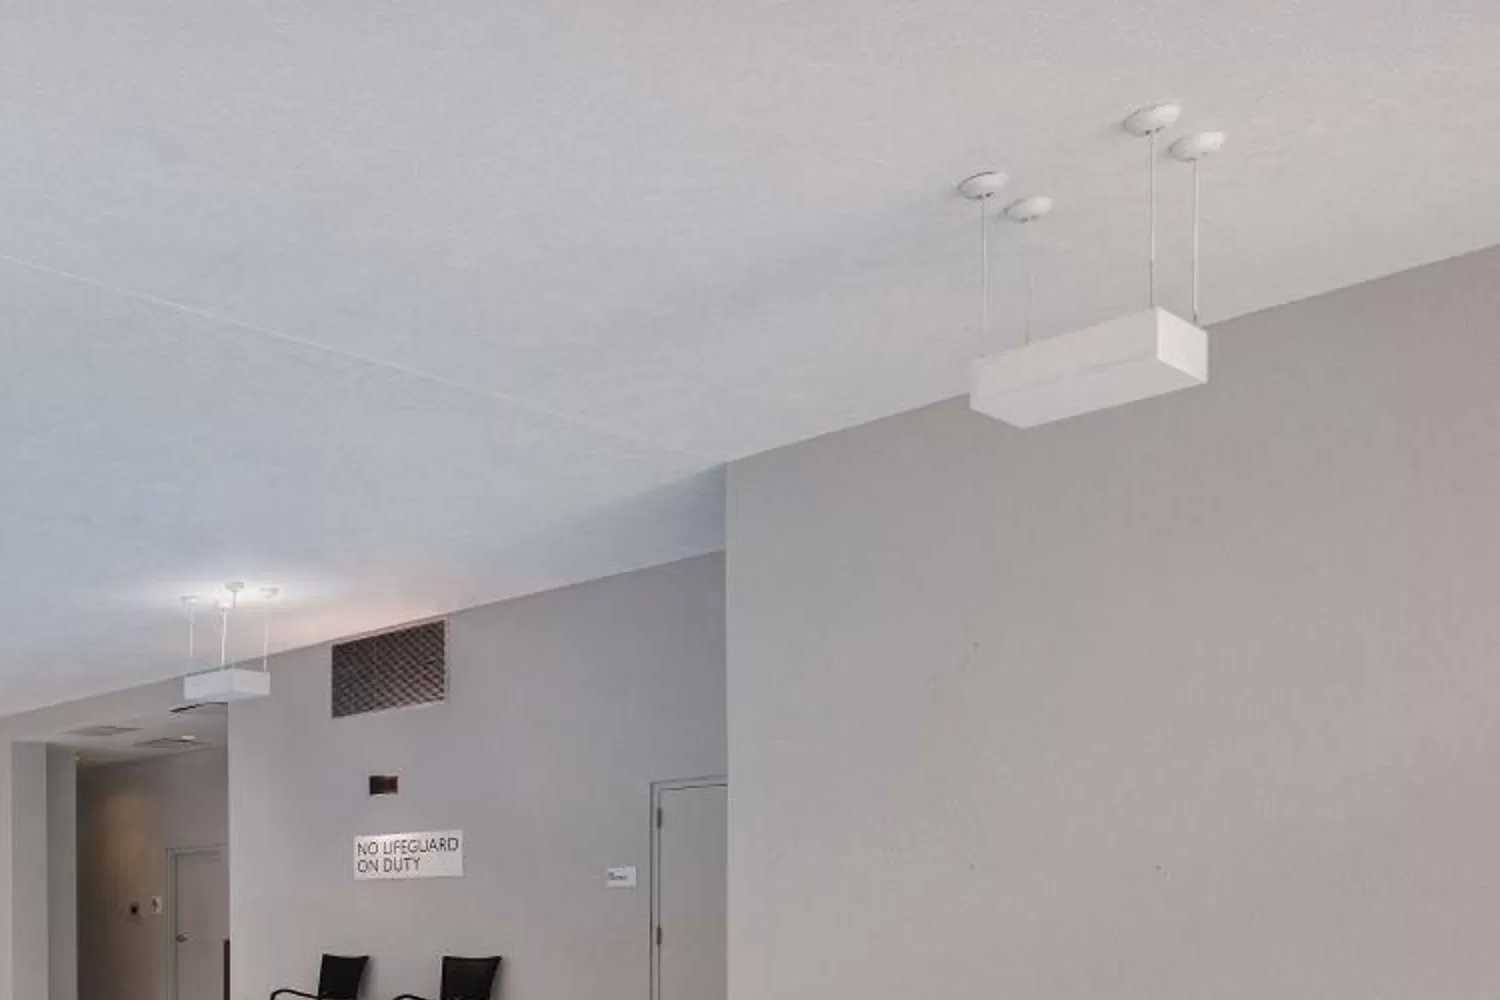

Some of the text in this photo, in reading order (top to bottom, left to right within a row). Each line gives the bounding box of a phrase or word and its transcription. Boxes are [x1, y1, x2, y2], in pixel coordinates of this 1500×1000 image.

[357, 837, 459, 856] NO LIFEGUARD
[357, 857, 421, 873] ON DUTY
